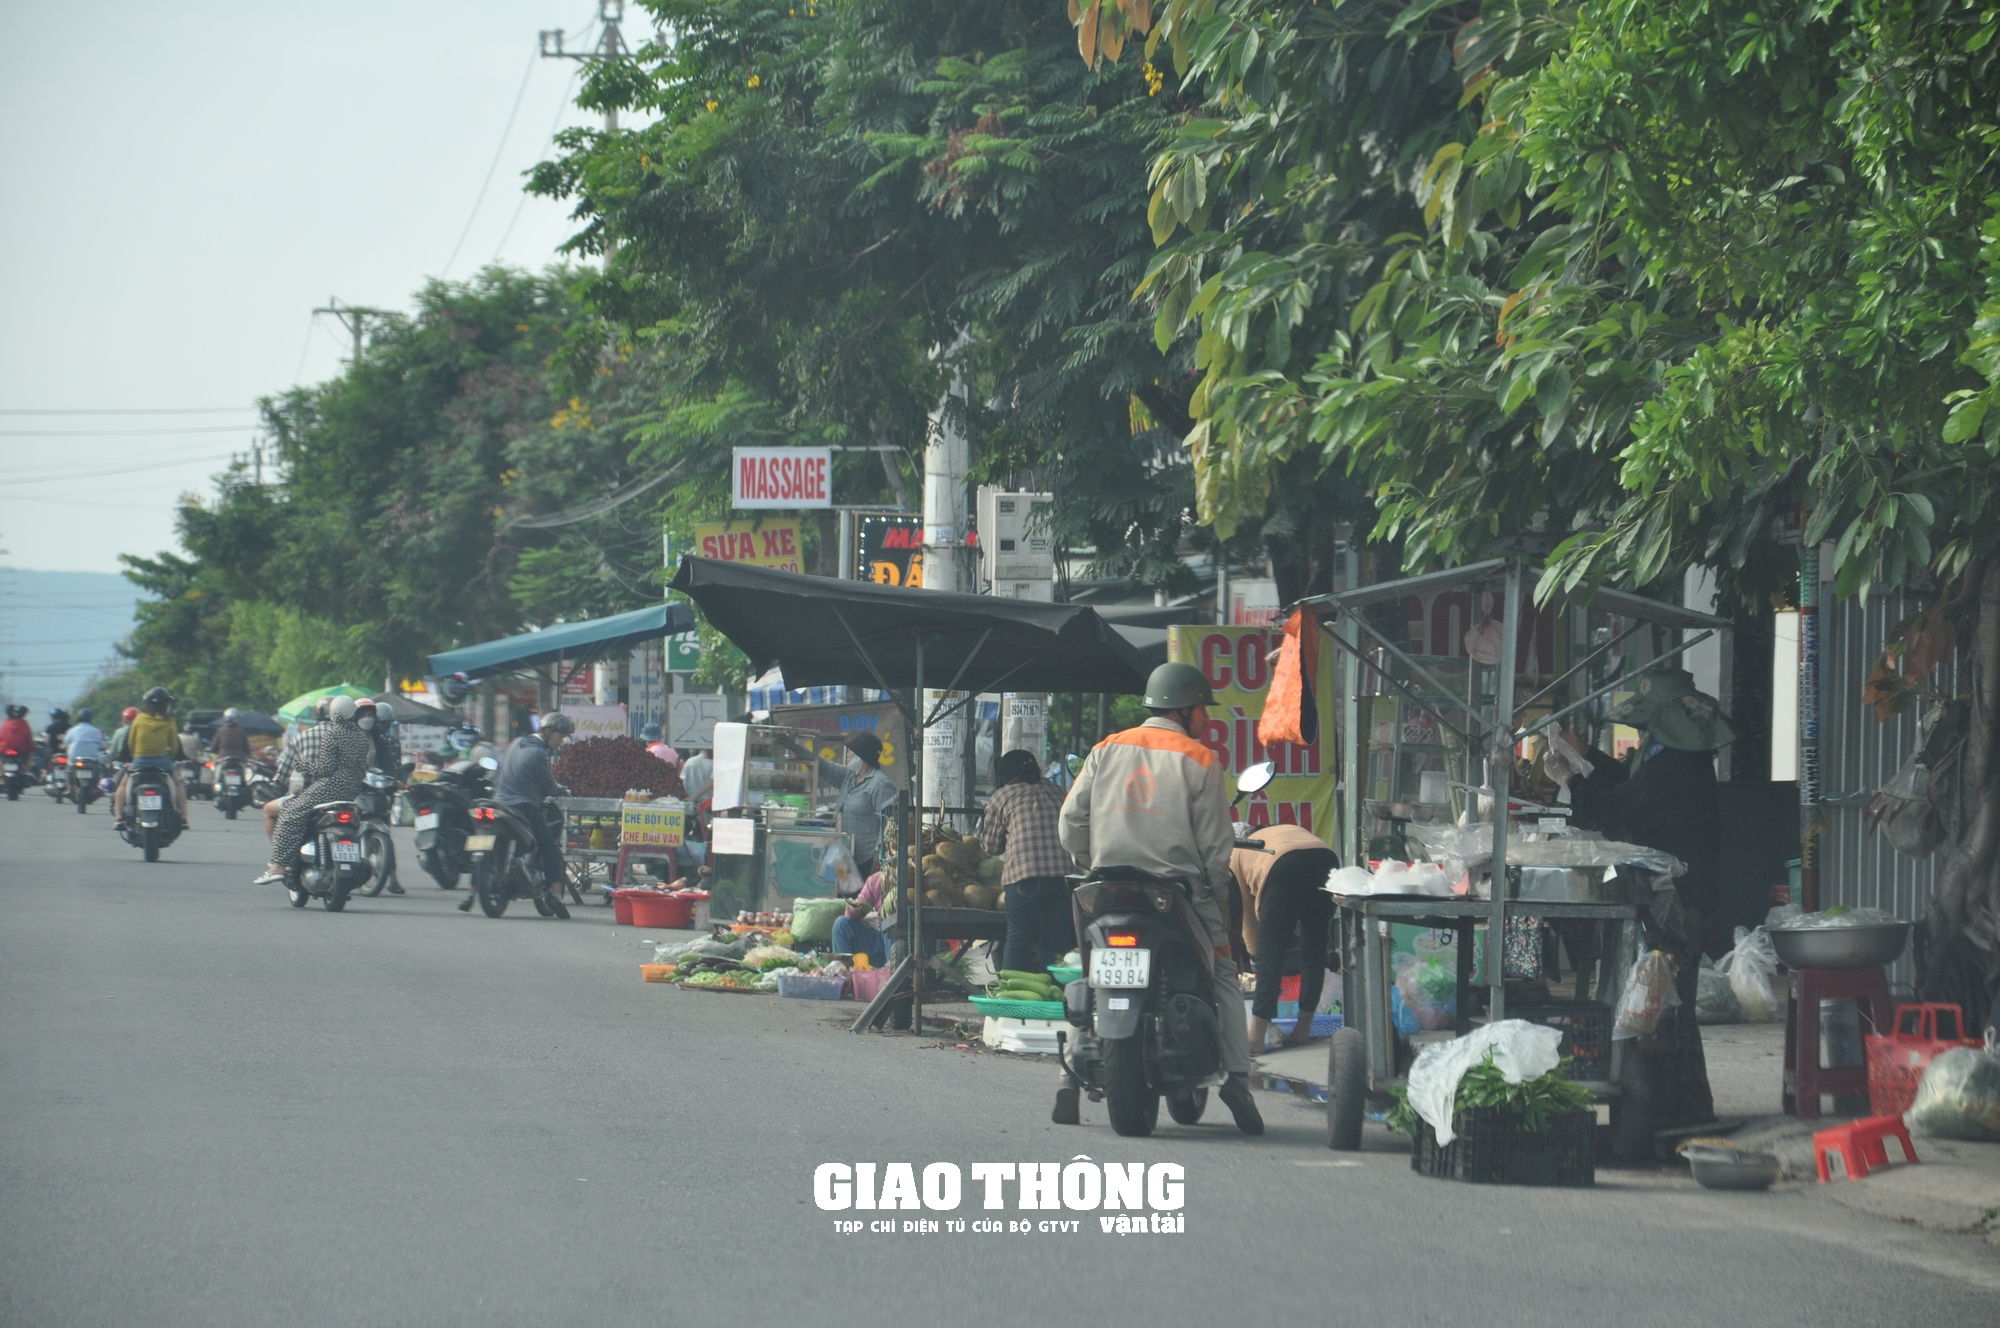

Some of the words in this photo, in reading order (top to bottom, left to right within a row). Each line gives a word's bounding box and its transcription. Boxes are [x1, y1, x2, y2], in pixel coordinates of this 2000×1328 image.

[741, 457, 826, 500] MASSAGE
[762, 528, 796, 557] XE
[645, 812, 661, 827] BỘT
[664, 815, 681, 828] LỌC
[1101, 951, 1140, 967] 43-H1
[1095, 969, 1145, 985] 199.84
